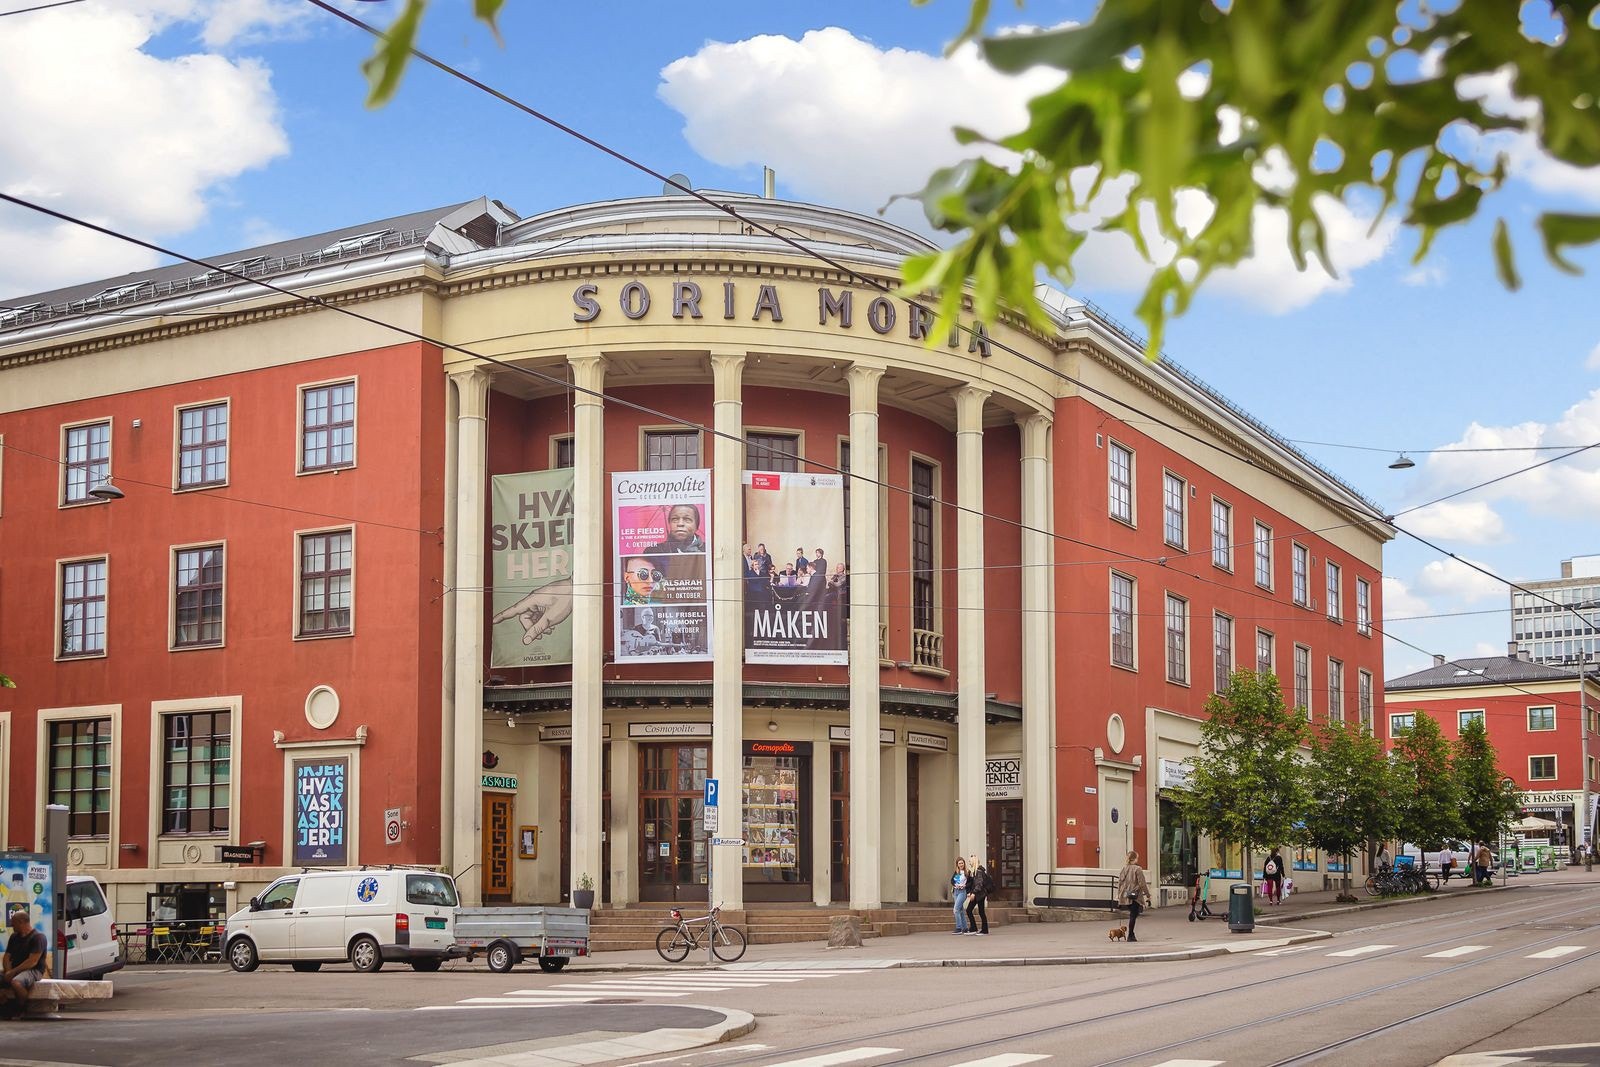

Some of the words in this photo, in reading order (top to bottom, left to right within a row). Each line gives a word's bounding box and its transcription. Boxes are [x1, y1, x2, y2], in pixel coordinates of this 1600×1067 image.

[572, 282, 783, 322] SORIA
[818, 287, 992, 358] MORIA
[618, 476, 705, 498] Cosmopolite
[519, 489, 574, 520] HVA
[507, 549, 569, 579] HER
[754, 604, 828, 638] MÅKEN
[644, 725, 695, 734] Cosmopolite
[752, 743, 794, 754] Cosmopolite
[986, 772, 1020, 784] TEATRET
[708, 783, 715, 802] P
[1534, 794, 1573, 802] HANSEN
[390, 826, 397, 836] 30
